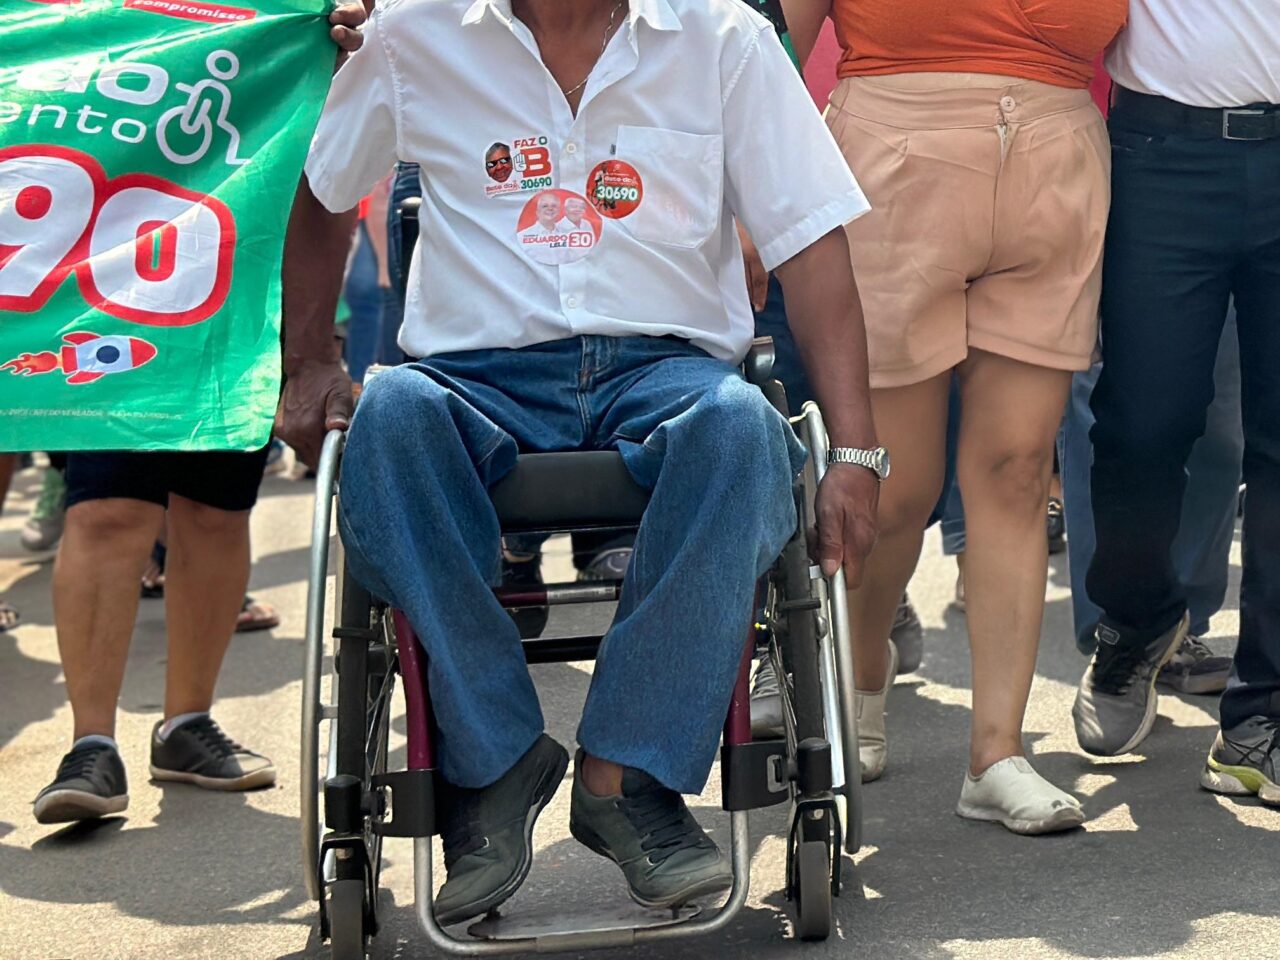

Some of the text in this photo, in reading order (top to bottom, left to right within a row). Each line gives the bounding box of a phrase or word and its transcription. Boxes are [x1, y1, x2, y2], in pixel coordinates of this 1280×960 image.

[514, 136, 548, 149] FAZ O
[521, 147, 552, 178] B
[520, 177, 552, 189] 30690
[597, 186, 638, 201] 30690
[523, 234, 568, 243] EDUARDO
[570, 233, 591, 247] 30
